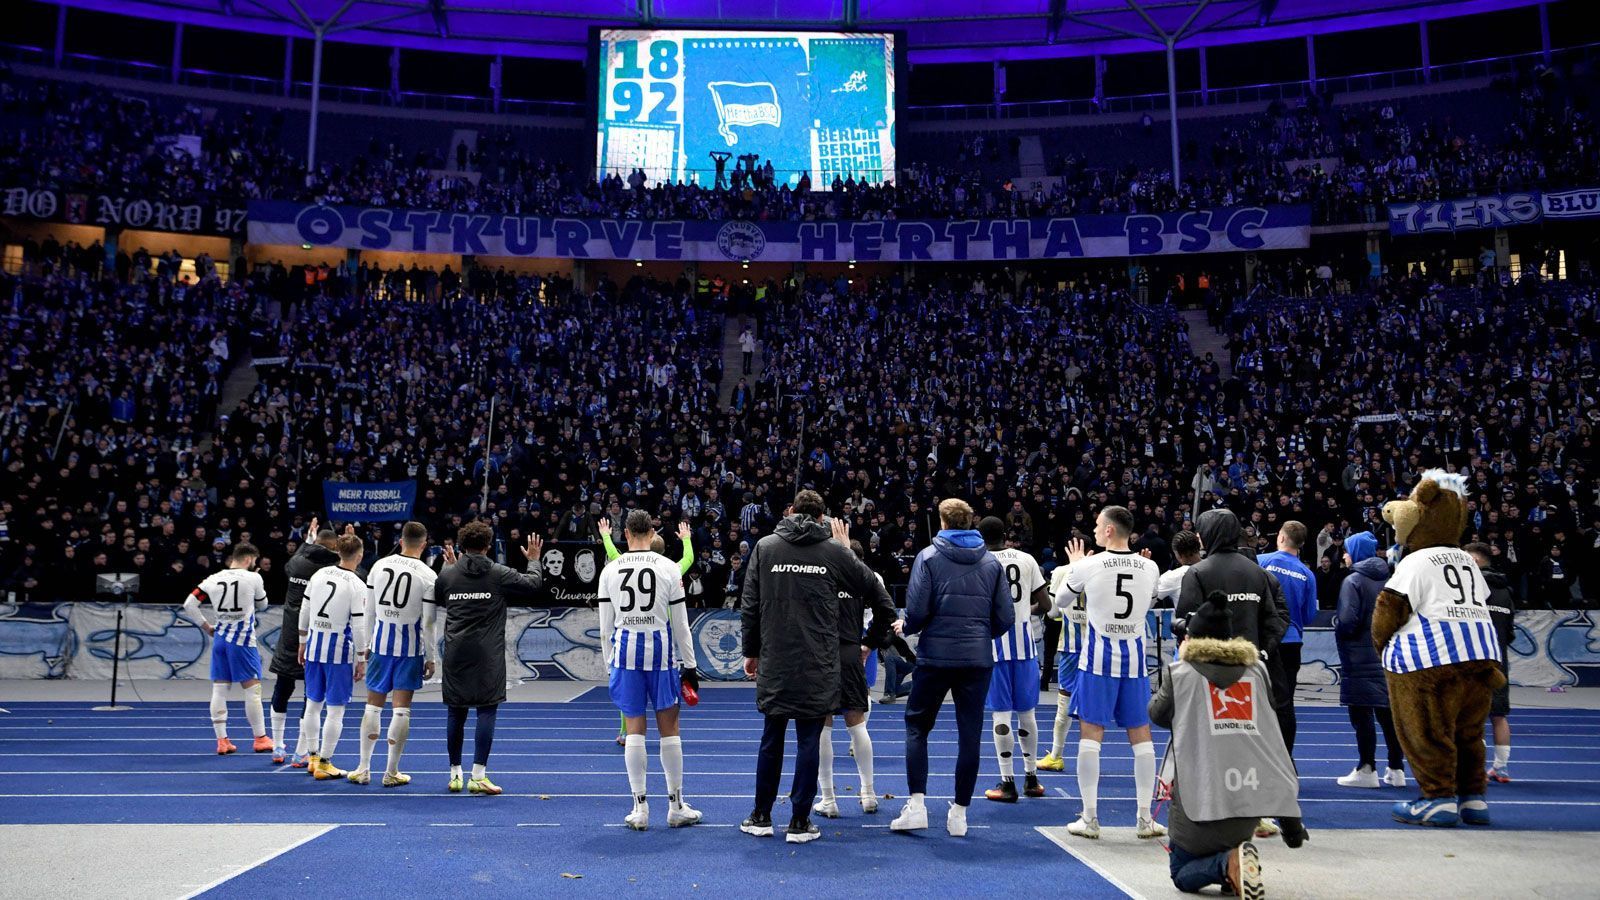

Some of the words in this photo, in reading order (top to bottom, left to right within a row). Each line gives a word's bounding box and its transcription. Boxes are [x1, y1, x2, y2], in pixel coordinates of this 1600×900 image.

[615, 40, 679, 79] 18
[613, 82, 678, 123] 92
[96, 195, 202, 232] NORD
[214, 208, 248, 233] 97
[1390, 194, 1541, 234] 71ERS
[295, 205, 685, 260] OSTKURVE
[797, 218, 1084, 261] HERTHA
[1123, 207, 1269, 255] BSC
[331, 502, 367, 512] WENIGER
[368, 500, 408, 512] GESCHÄFT
[338, 489, 362, 499] MEHR
[364, 489, 402, 499] FUSSBALL
[618, 553, 645, 565] HERTHA
[771, 564, 827, 575] AUTOHERO
[1102, 557, 1132, 569] HERTHA
[1133, 559, 1146, 571] BSC
[1266, 565, 1308, 582] AUTOHERO
[217, 580, 243, 612] 21
[317, 580, 337, 618] 2
[379, 568, 412, 609] 20
[448, 592, 492, 600] AUTOHERO
[618, 568, 656, 612] 39
[1114, 573, 1134, 619] 5
[1443, 564, 1483, 607] 92
[622, 616, 656, 626] SCHERHANT
[1224, 767, 1260, 792] 04
